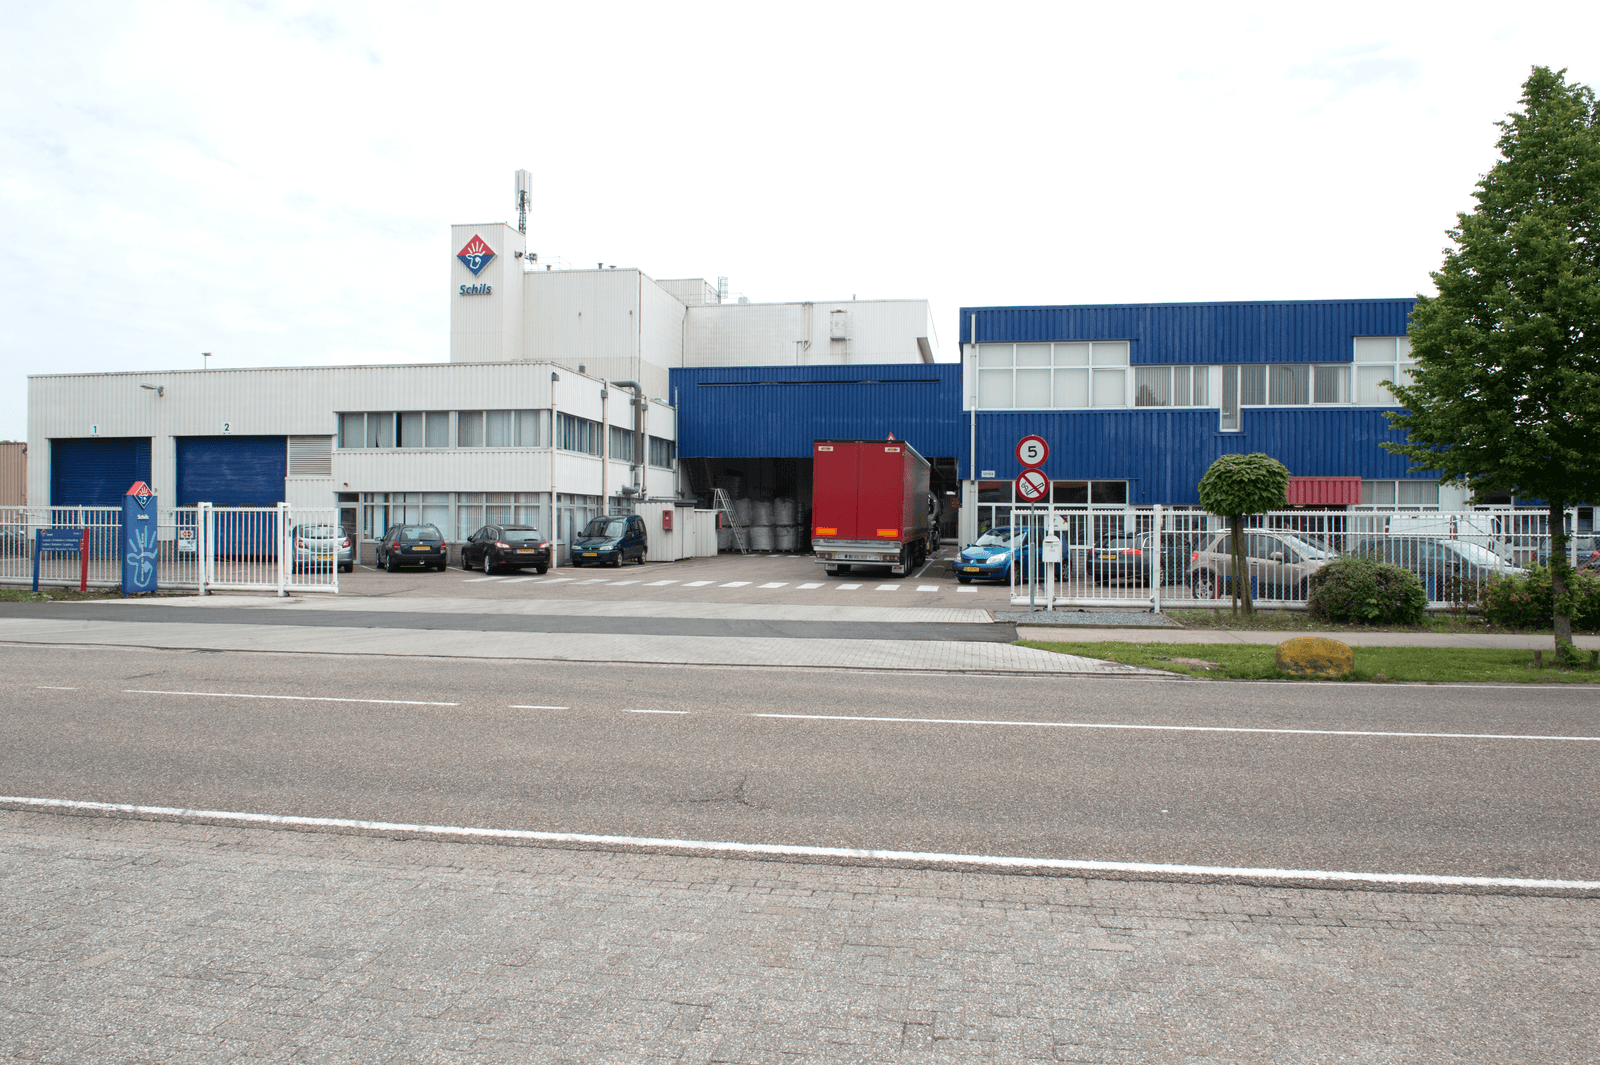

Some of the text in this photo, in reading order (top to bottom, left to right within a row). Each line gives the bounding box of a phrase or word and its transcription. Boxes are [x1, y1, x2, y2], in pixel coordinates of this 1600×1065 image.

[459, 283, 492, 295] Schils
[93, 425, 97, 433] 1
[224, 423, 230, 432] 2
[1028, 445, 1038, 458] 5
